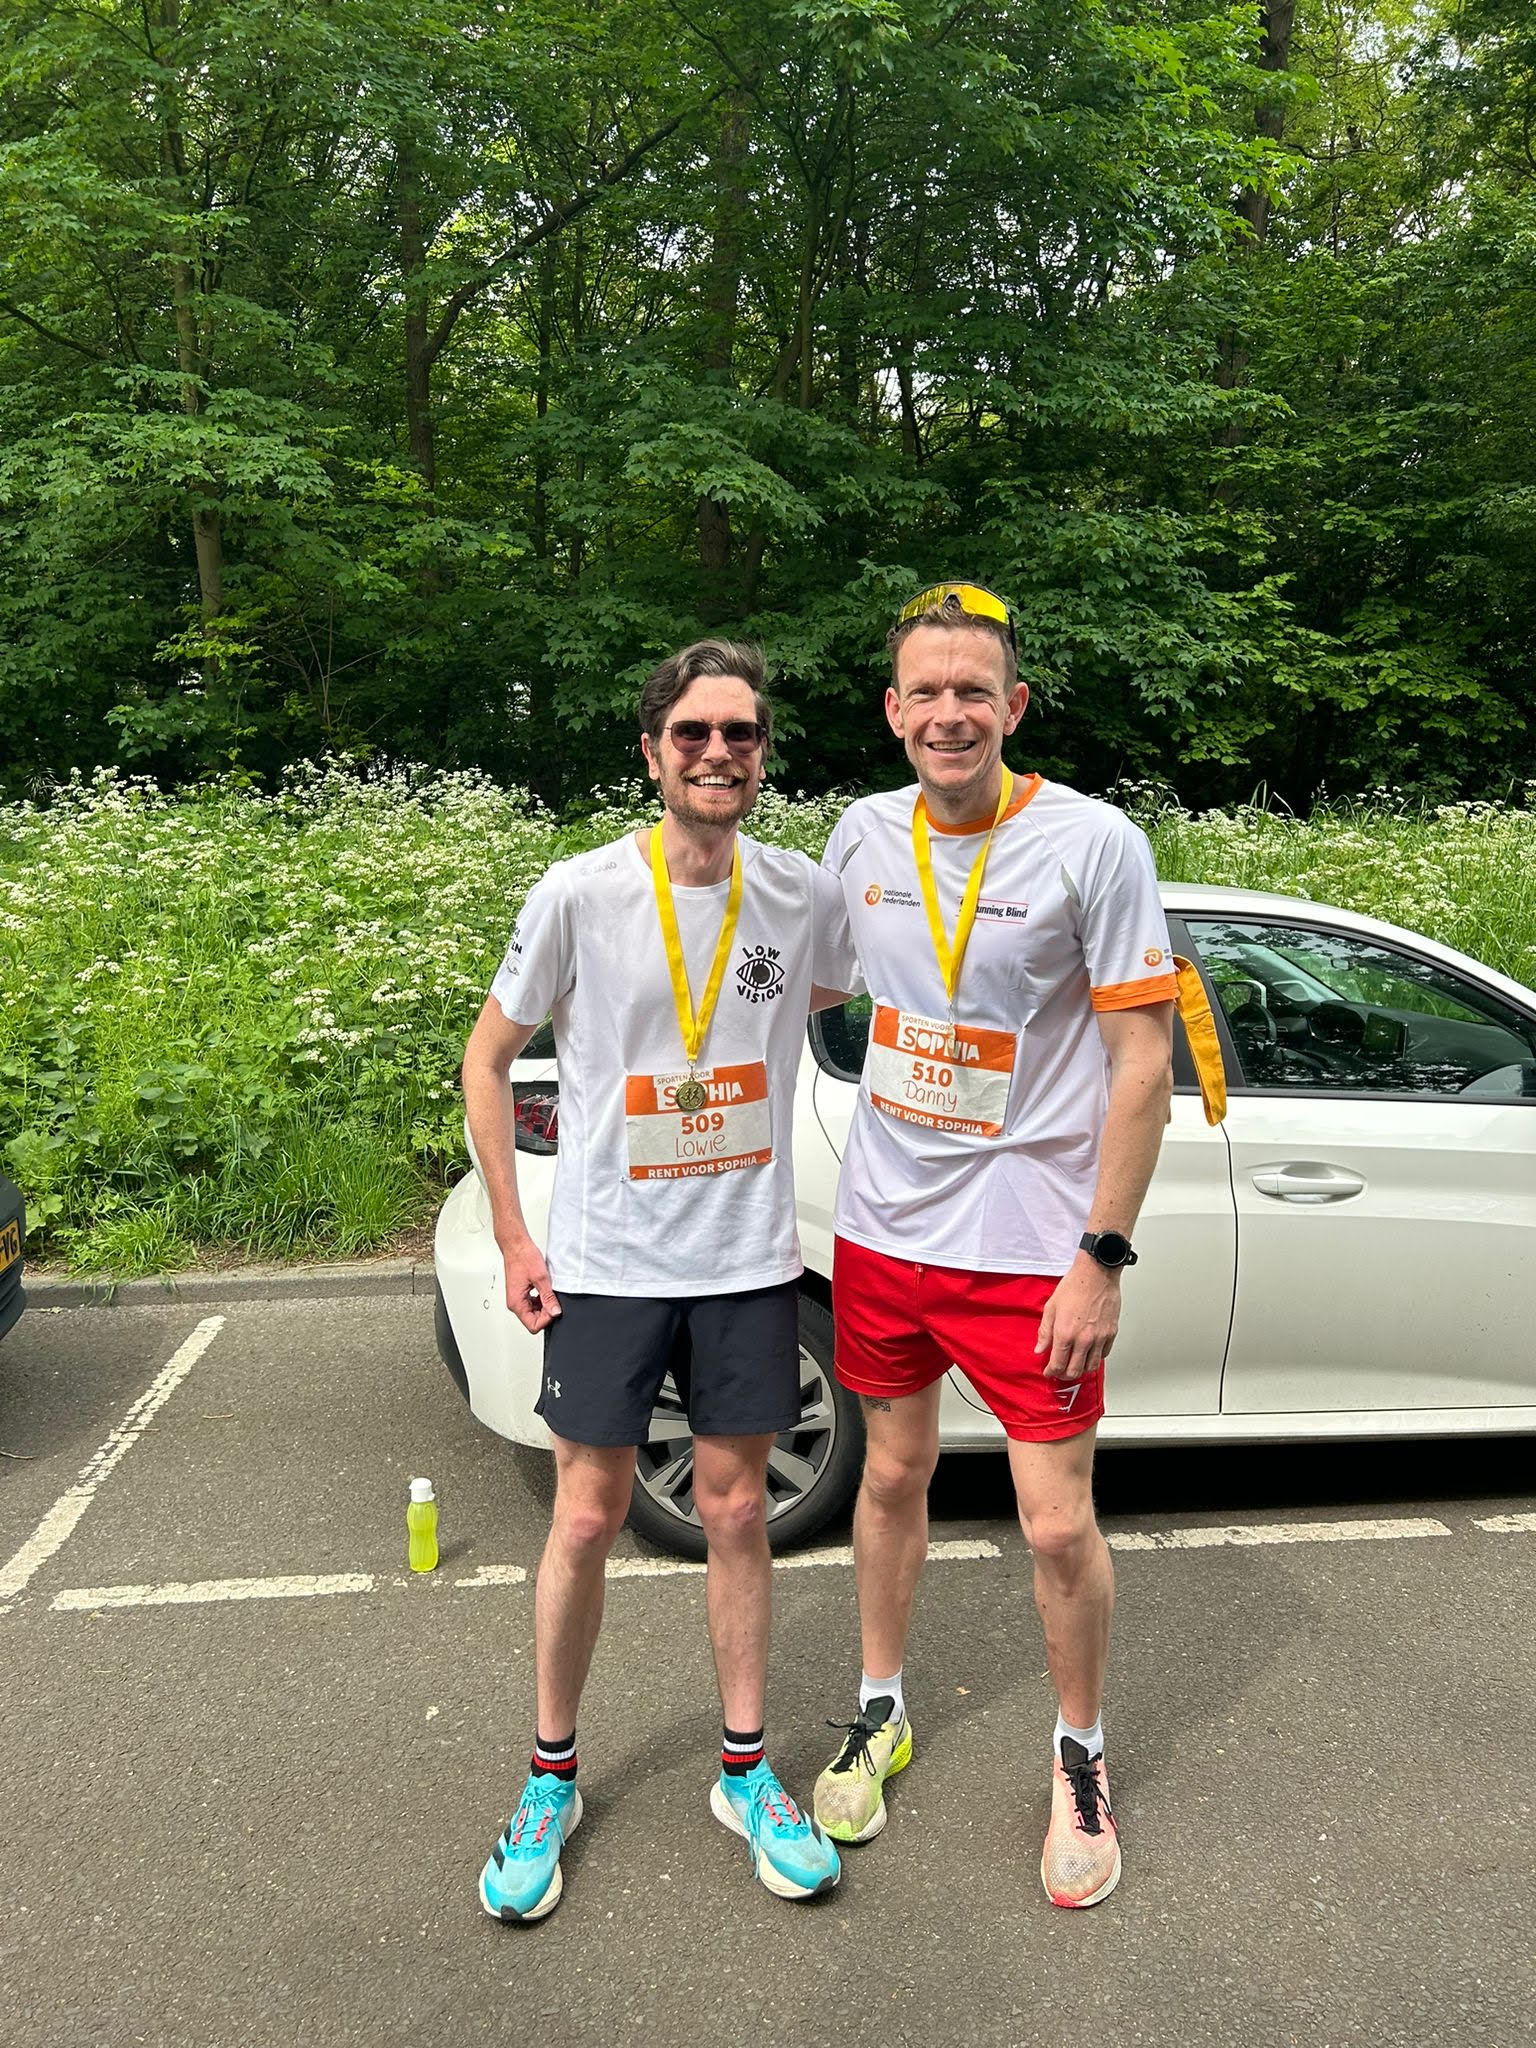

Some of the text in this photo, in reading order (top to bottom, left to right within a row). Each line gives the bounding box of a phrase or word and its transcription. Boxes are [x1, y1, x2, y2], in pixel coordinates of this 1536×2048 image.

[882, 897, 921, 908] nederlanden
[883, 889, 912, 899] nationale
[976, 904, 1028, 918] unning Blind
[742, 945, 781, 960] LOW
[736, 984, 783, 1004] VISION
[901, 1015, 930, 1027] SPORTEN
[657, 1074, 688, 1085] SPORTEN
[911, 1060, 953, 1088] 510
[902, 1079, 958, 1113] Danny
[681, 1112, 725, 1135] 509
[880, 1101, 983, 1135] RENT VOOR SOPHIA
[675, 1134, 728, 1158] Lowie
[648, 1155, 758, 1179] RENT VOOR SOPHIA
